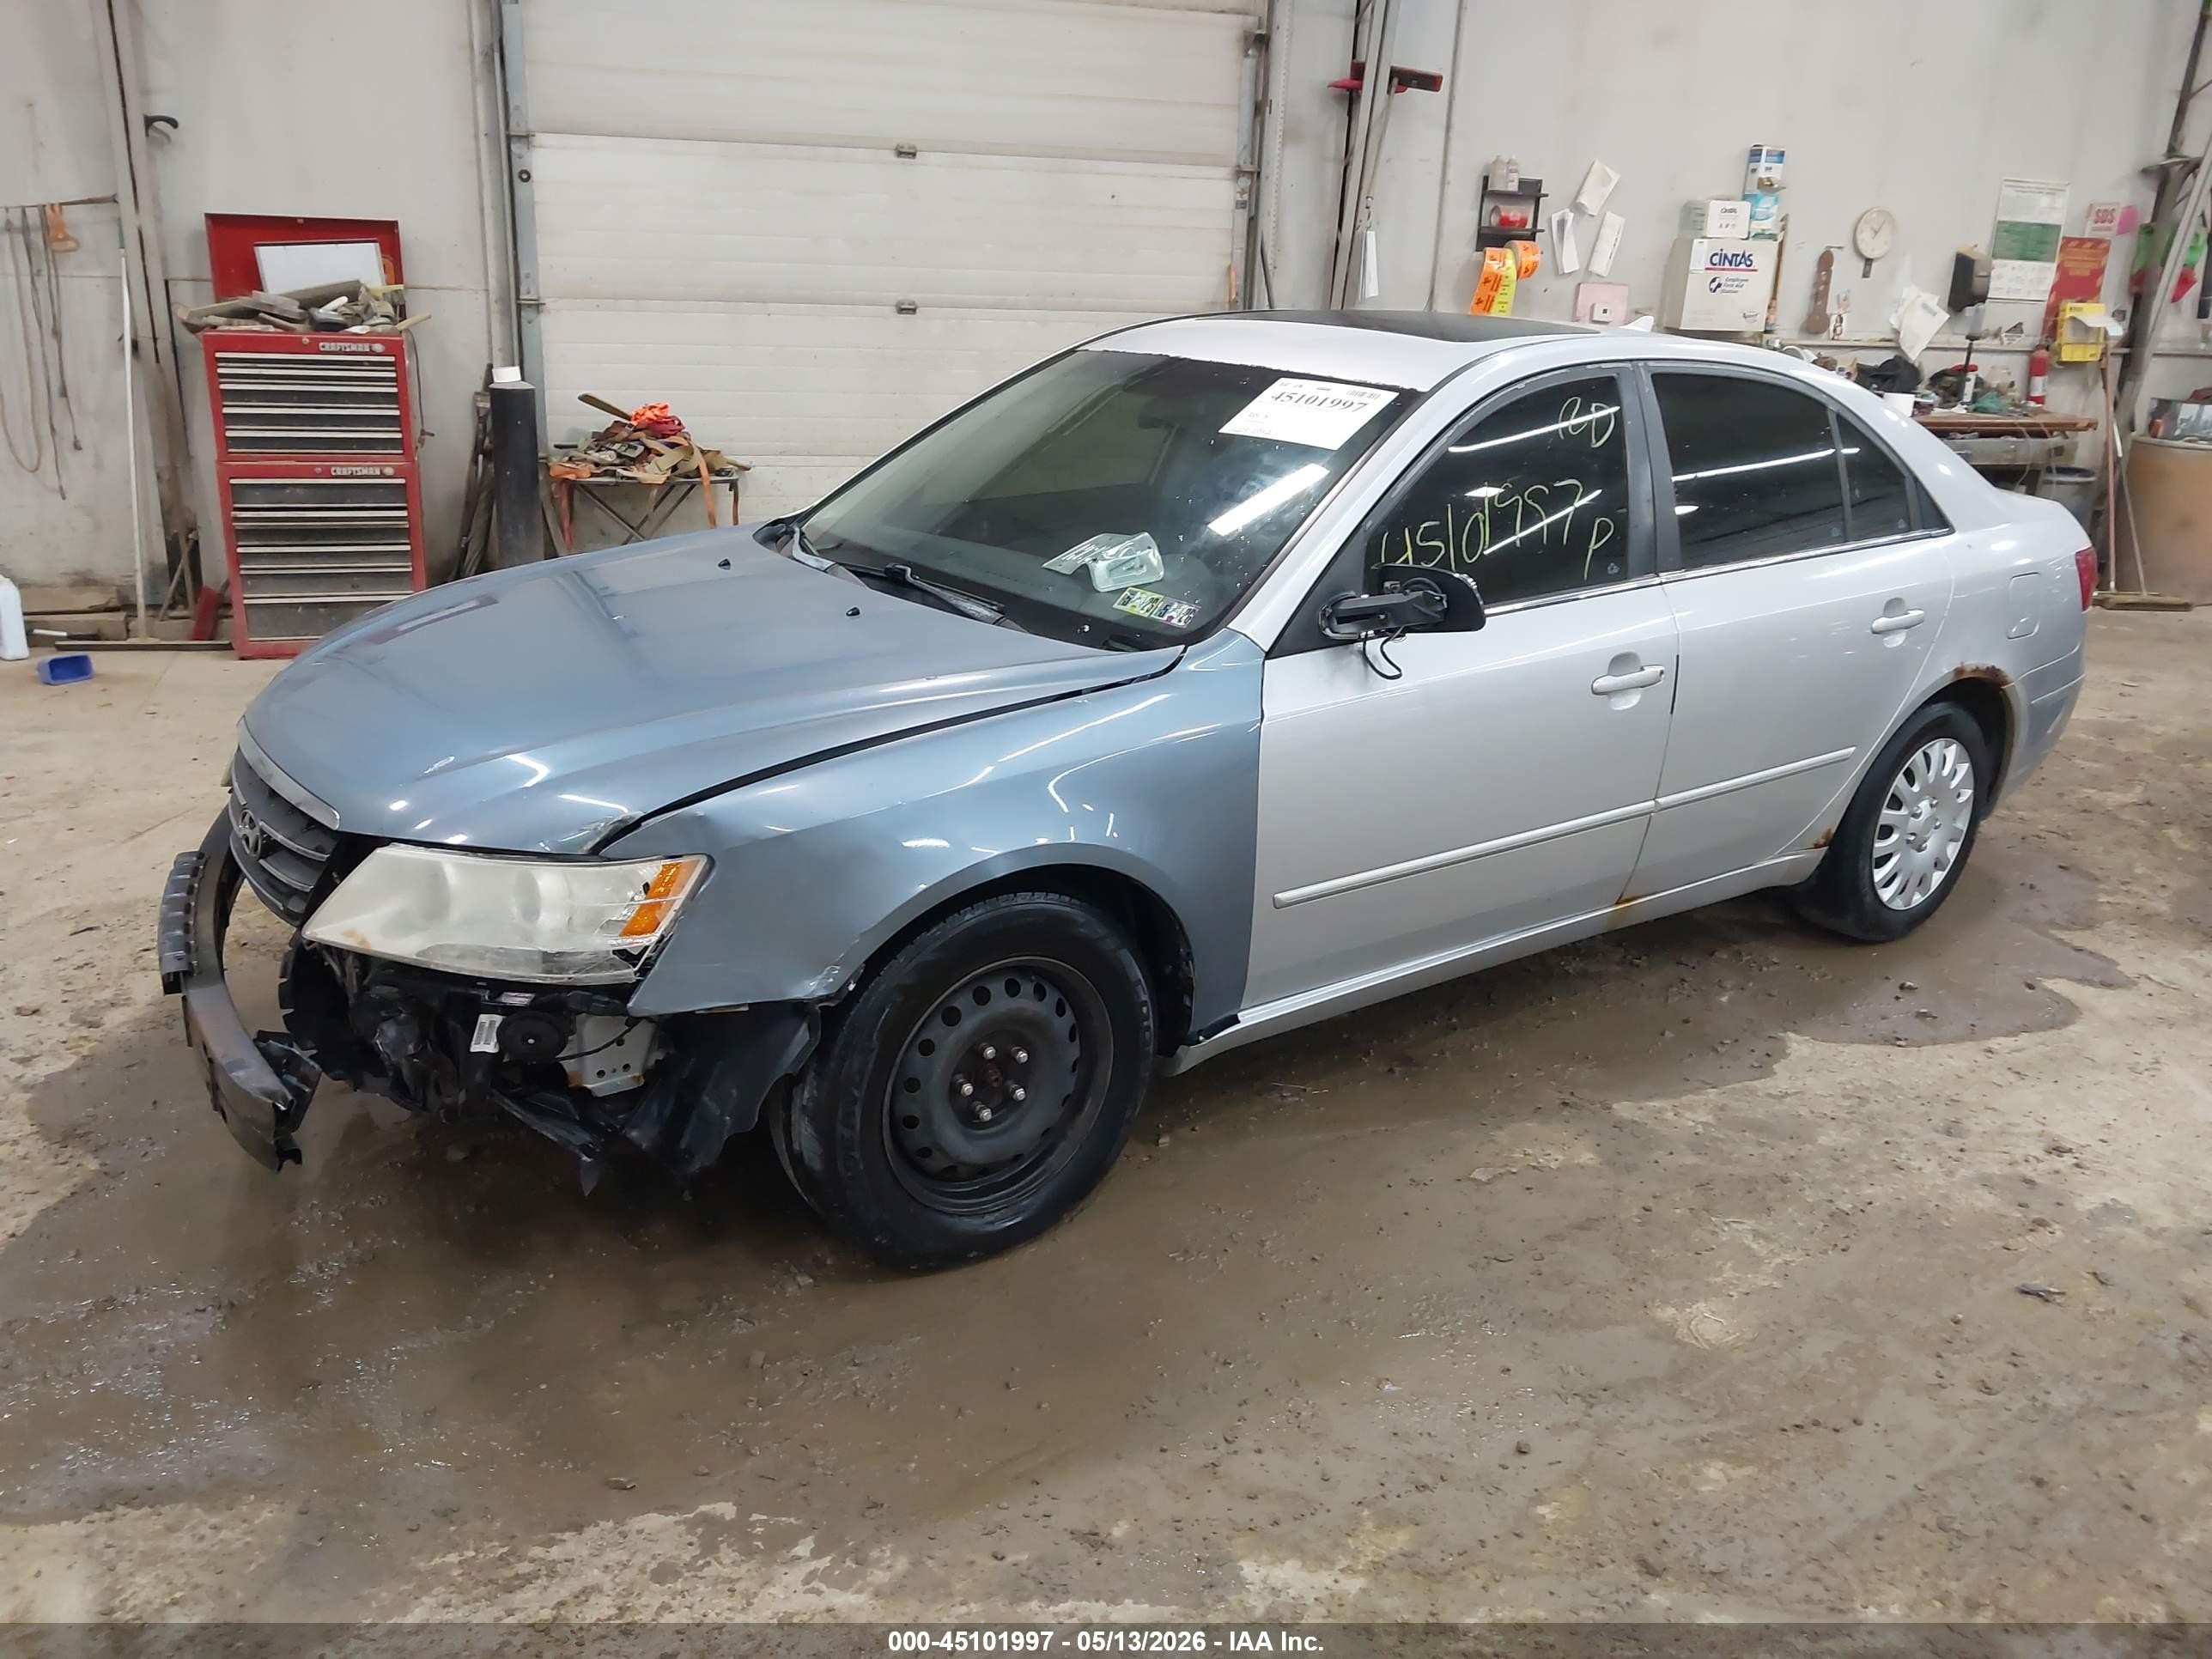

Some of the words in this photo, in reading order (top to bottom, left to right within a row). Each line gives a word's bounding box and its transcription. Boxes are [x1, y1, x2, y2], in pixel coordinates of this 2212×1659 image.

[2094, 208, 2116, 224] SDS
[1710, 248, 1753, 268] CINTAS
[319, 343, 370, 352] CRAFTSMAN
[1271, 391, 1369, 413] 45101997
[330, 466, 380, 476] CRAFTSMAN
[1158, 604, 1171, 617] 5
